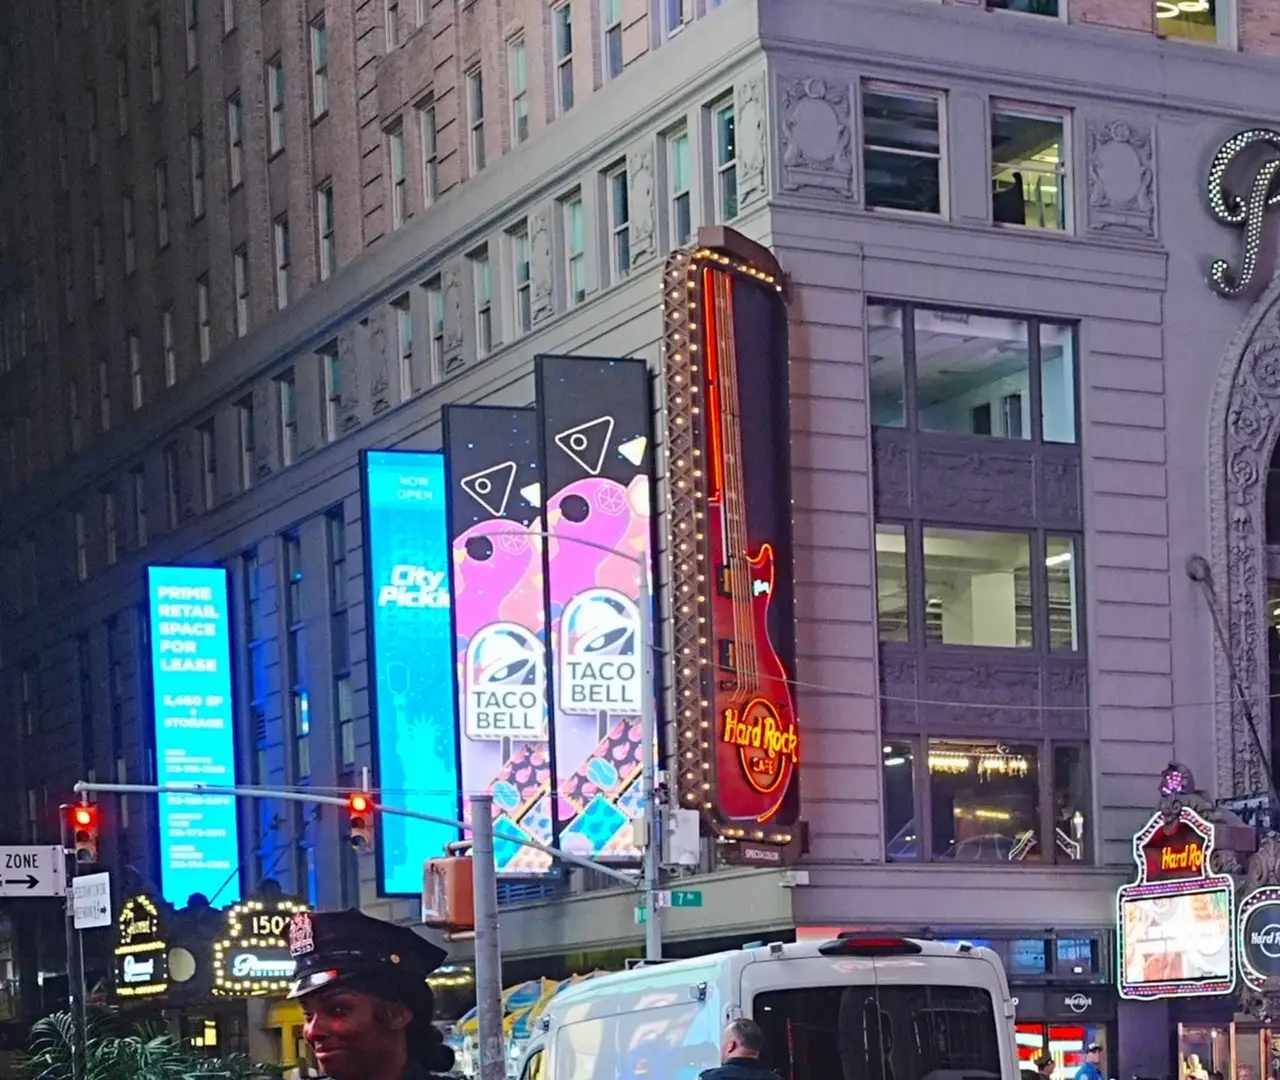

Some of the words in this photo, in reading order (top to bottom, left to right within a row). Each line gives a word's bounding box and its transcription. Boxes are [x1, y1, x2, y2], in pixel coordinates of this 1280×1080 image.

[397, 490, 433, 500] OPEN
[391, 564, 444, 592] City
[157, 585, 212, 600] PRIME
[158, 604, 220, 619] RETAIL
[159, 622, 216, 636] SPACE
[160, 640, 197, 653] FOR
[160, 658, 217, 672] LEASE
[566, 662, 635, 681] TACO
[472, 691, 537, 709] TACO
[571, 684, 633, 703] BELL
[476, 712, 535, 729] BELL
[724, 708, 762, 748] Hard
[764, 717, 798, 763] Rock
[752, 757, 775, 775] CAFE
[5, 853, 39, 869] ZONE
[1162, 846, 1188, 870] Hard
[677, 892, 684, 905] 7
[1251, 932, 1274, 945] Hard
